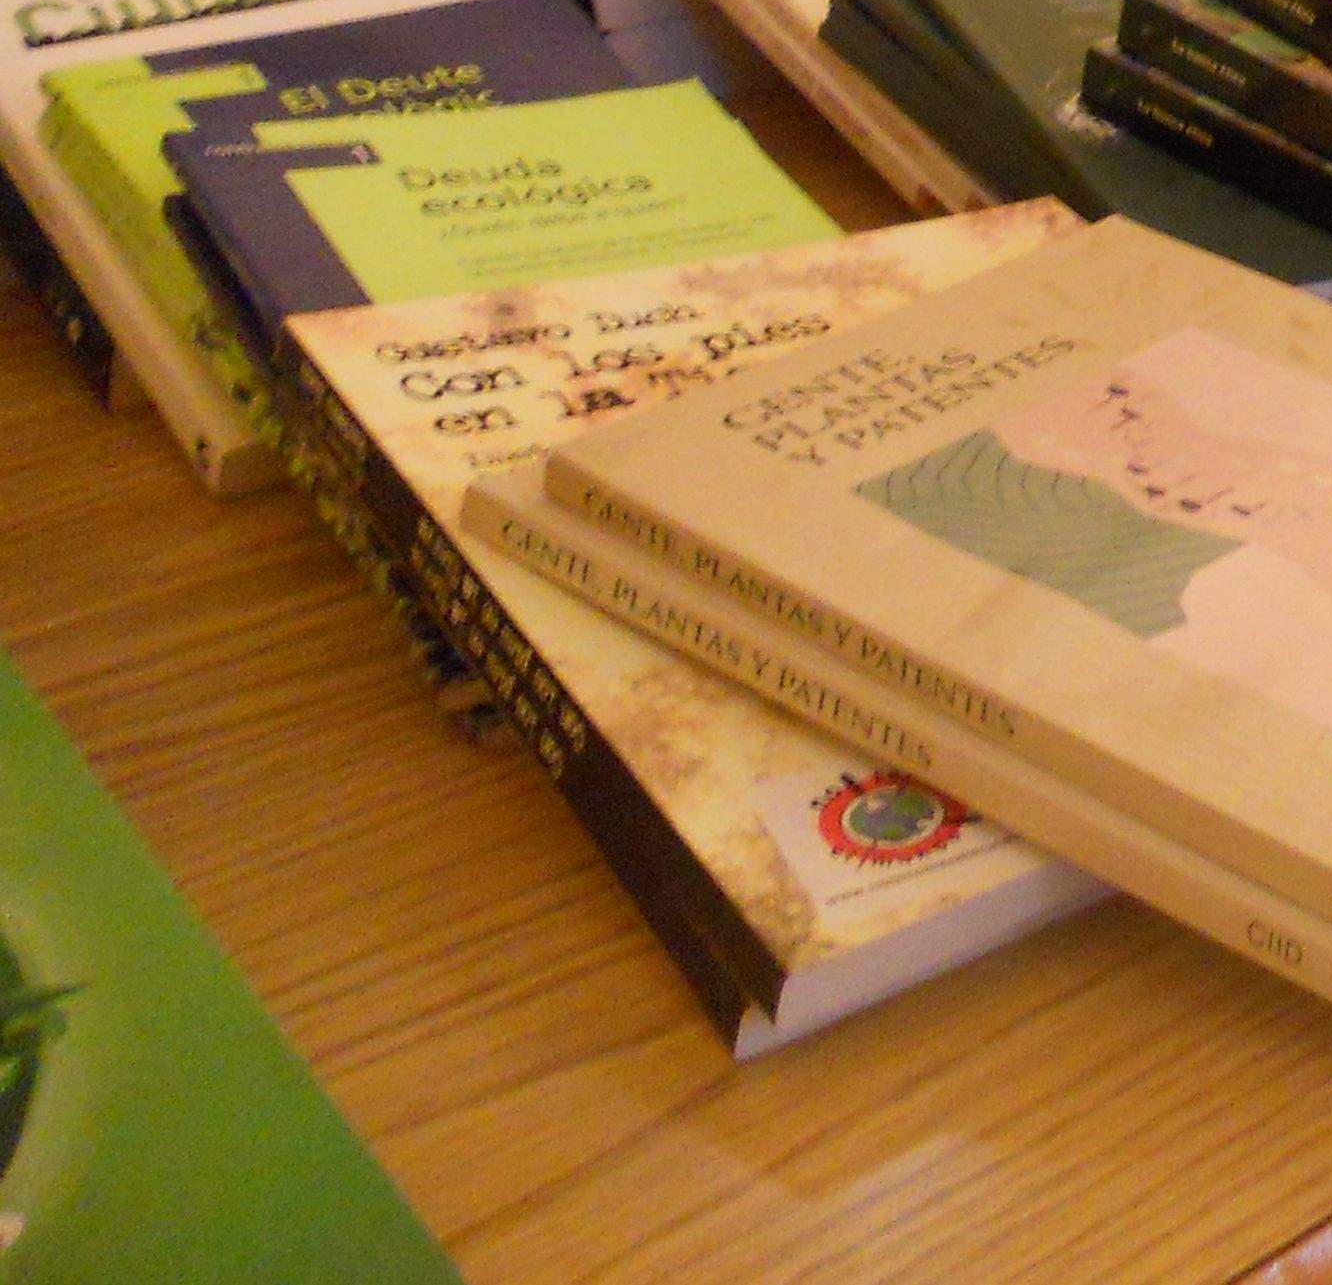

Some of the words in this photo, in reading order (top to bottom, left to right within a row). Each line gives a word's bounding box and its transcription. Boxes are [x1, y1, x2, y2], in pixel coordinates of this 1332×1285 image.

[279, 83, 330, 115] El
[335, 63, 484, 107] Deute
[397, 156, 564, 192] Deuda
[399, 366, 526, 402] Con
[548, 343, 667, 381] los
[692, 314, 831, 362] pies
[754, 348, 977, 452] PLANTAS
[788, 444, 826, 467] Y
[835, 334, 1075, 452] PATENTES
[434, 406, 522, 436] en
[540, 387, 637, 418] la
[610, 575, 748, 669] PLANTAS
[777, 666, 933, 770] PATENTES
[693, 547, 828, 635] PLANTAS
[859, 634, 1017, 738] PATENTES
